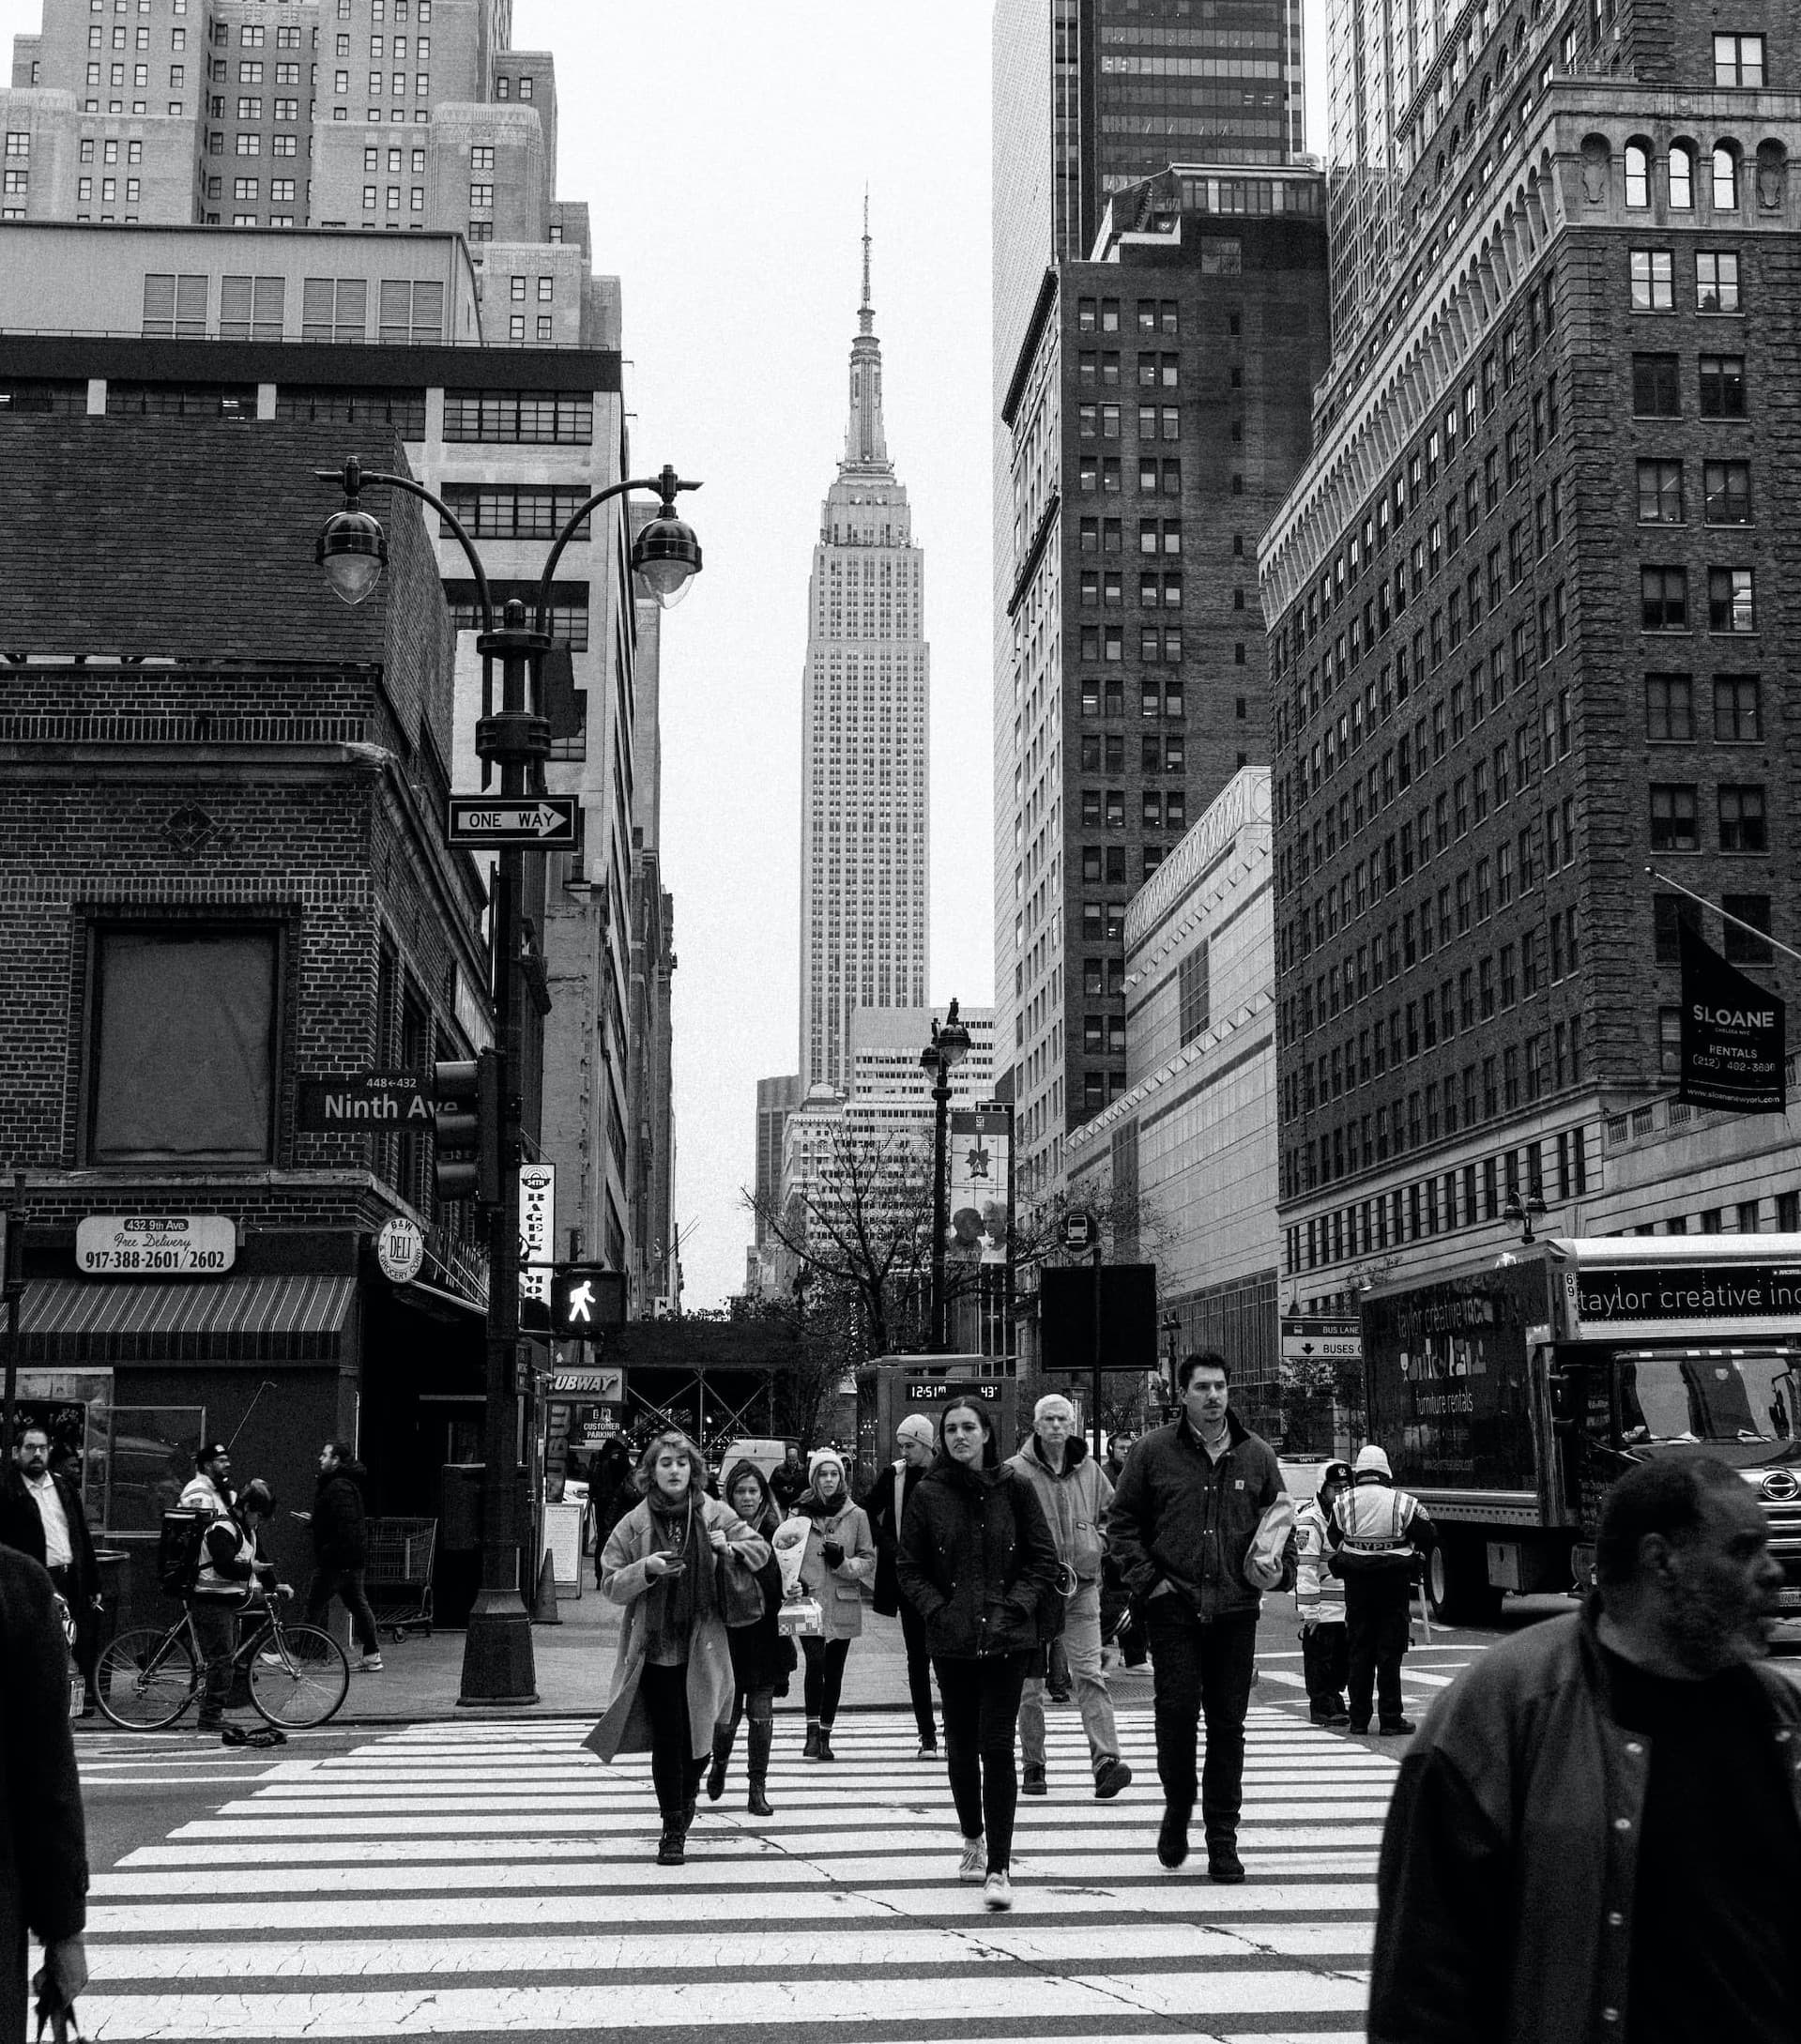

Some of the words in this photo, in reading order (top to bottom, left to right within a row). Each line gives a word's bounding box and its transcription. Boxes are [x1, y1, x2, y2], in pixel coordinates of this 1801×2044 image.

[469, 813, 501, 827] ONE
[518, 812, 554, 827] WAY
[1693, 1004, 1774, 1028] SLOANE
[1709, 1044, 1758, 1059] RENTALS
[1692, 1053, 1720, 1069] (212)
[366, 1078, 387, 1089] 448
[396, 1078, 417, 1089] 432
[325, 1093, 398, 1119] Ninth
[127, 1220, 146, 1230] 432
[149, 1220, 164, 1230] 9th
[114, 1232, 139, 1247] Free
[142, 1232, 191, 1251] Delivery
[389, 1235, 412, 1259] DELI
[85, 1250, 225, 1269] 917-388-2601/2602
[1580, 1286, 1652, 1317] taylor
[1659, 1282, 1763, 1308] creative
[1425, 1301, 1463, 1333] creative
[1322, 1325, 1338, 1335] BUS
[1339, 1325, 1360, 1335] LANE
[1322, 1344, 1355, 1354] BUSES
[548, 1375, 618, 1391] UBWAY
[1416, 1390, 1446, 1415] furniture
[1447, 1385, 1473, 1413] rentals
[583, 1423, 620, 1431] CUSTOMER
[1354, 1542, 1394, 1550] NYPD
